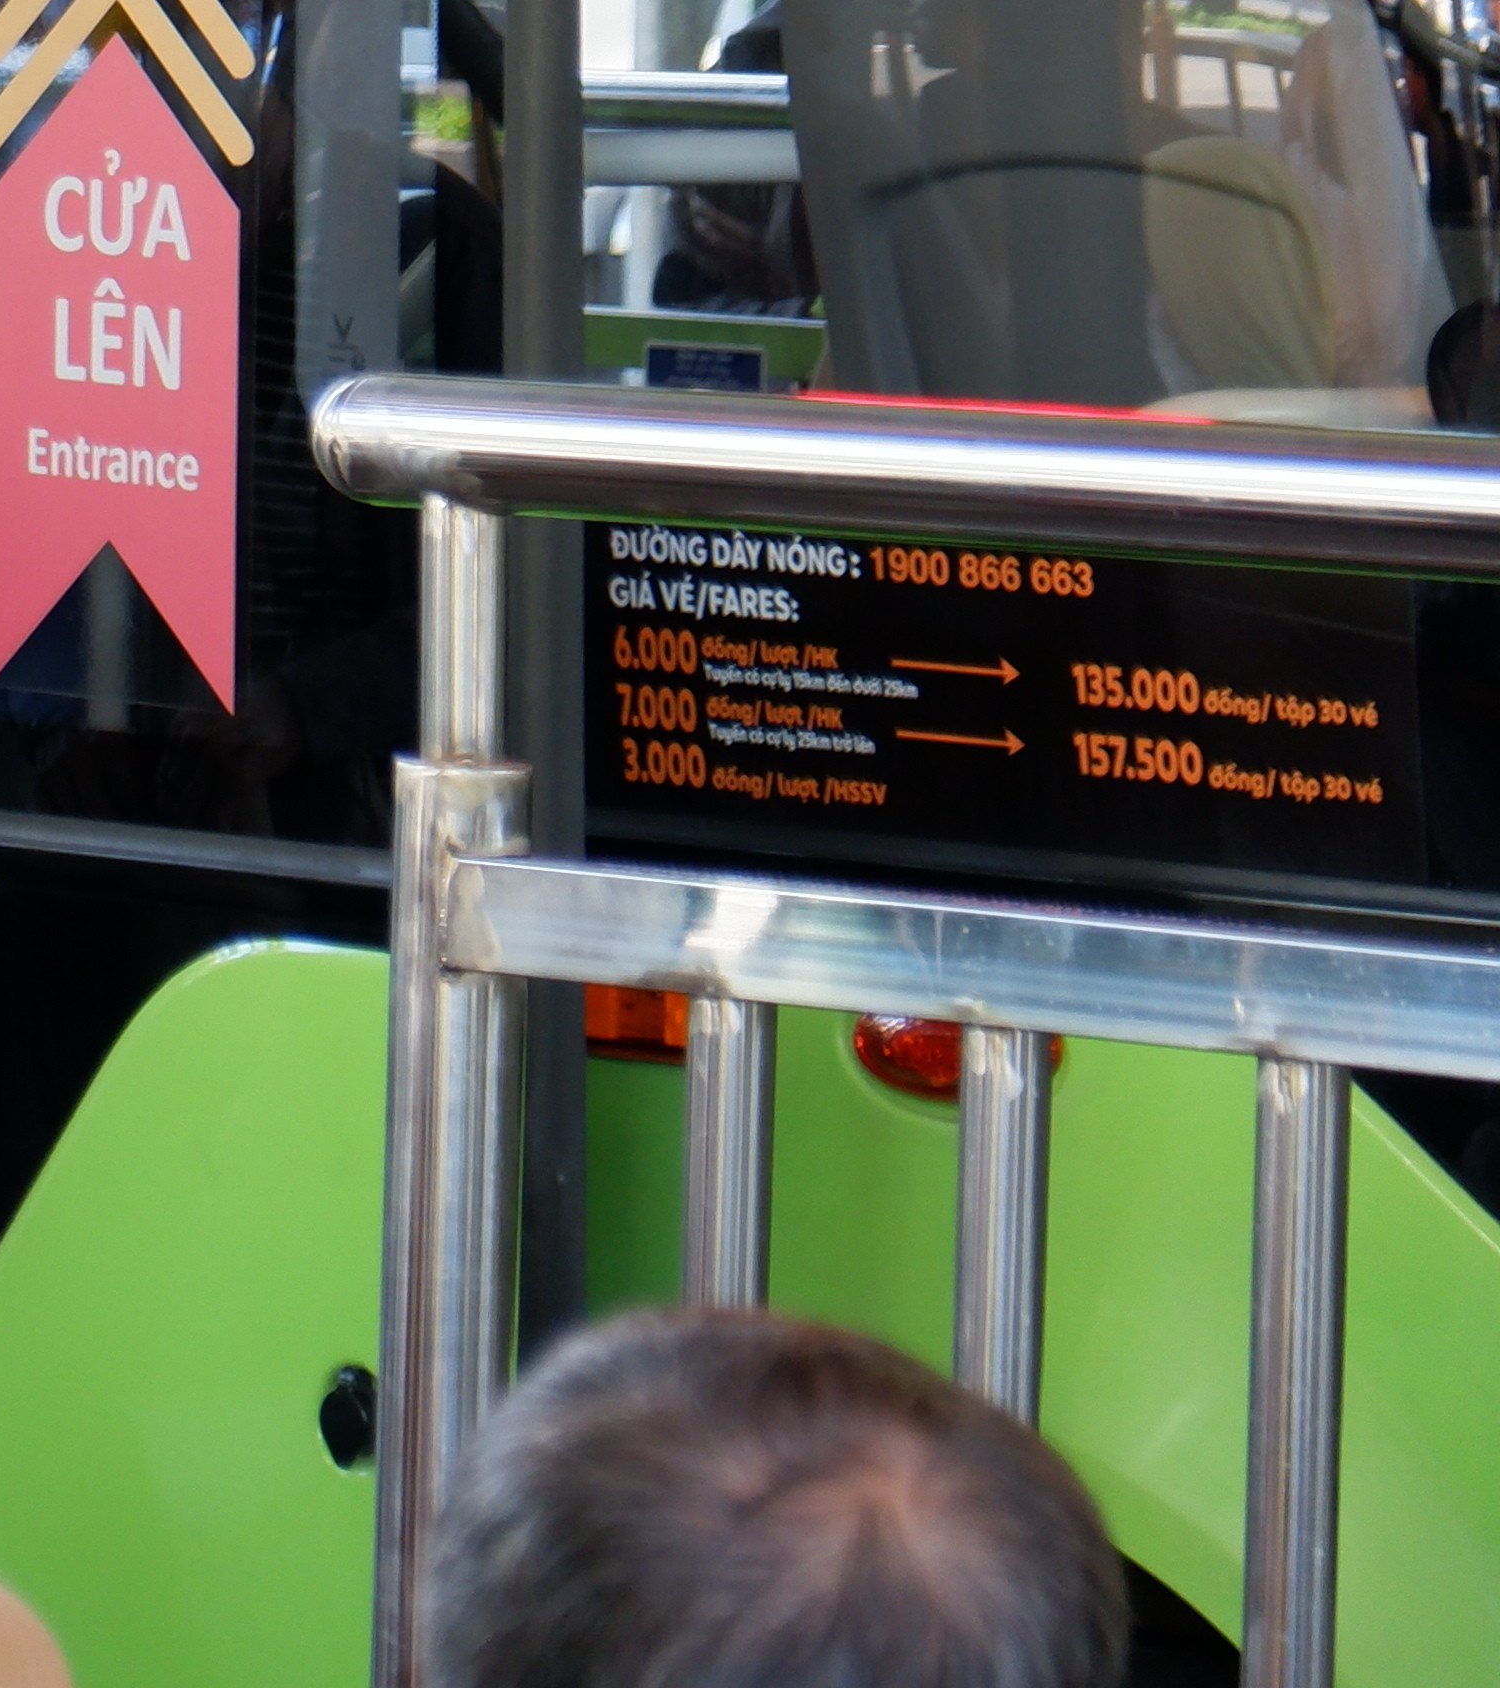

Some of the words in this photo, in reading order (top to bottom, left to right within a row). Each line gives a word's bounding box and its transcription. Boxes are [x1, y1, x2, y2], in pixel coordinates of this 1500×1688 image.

[43, 148, 192, 261] CỬA
[55, 277, 182, 390] LÊN
[27, 426, 200, 491] Entrance
[607, 570, 657, 610] GIÁ
[609, 523, 708, 566] ĐƯỜNG
[710, 530, 763, 571] DÂY
[868, 546, 950, 587] 1900
[958, 552, 1022, 593] 866
[1030, 557, 1095, 599] 663
[613, 624, 698, 675] 6.000
[614, 682, 698, 734] 7.000
[1071, 662, 1200, 714] 135.000
[1317, 698, 1347, 726] 30
[1349, 700, 1379, 728] vé
[621, 736, 707, 789] 3.000
[822, 775, 888, 806] /HSSV
[1072, 731, 1204, 786] 157.500
[1322, 774, 1351, 801] 30
[1353, 776, 1384, 804] vé
